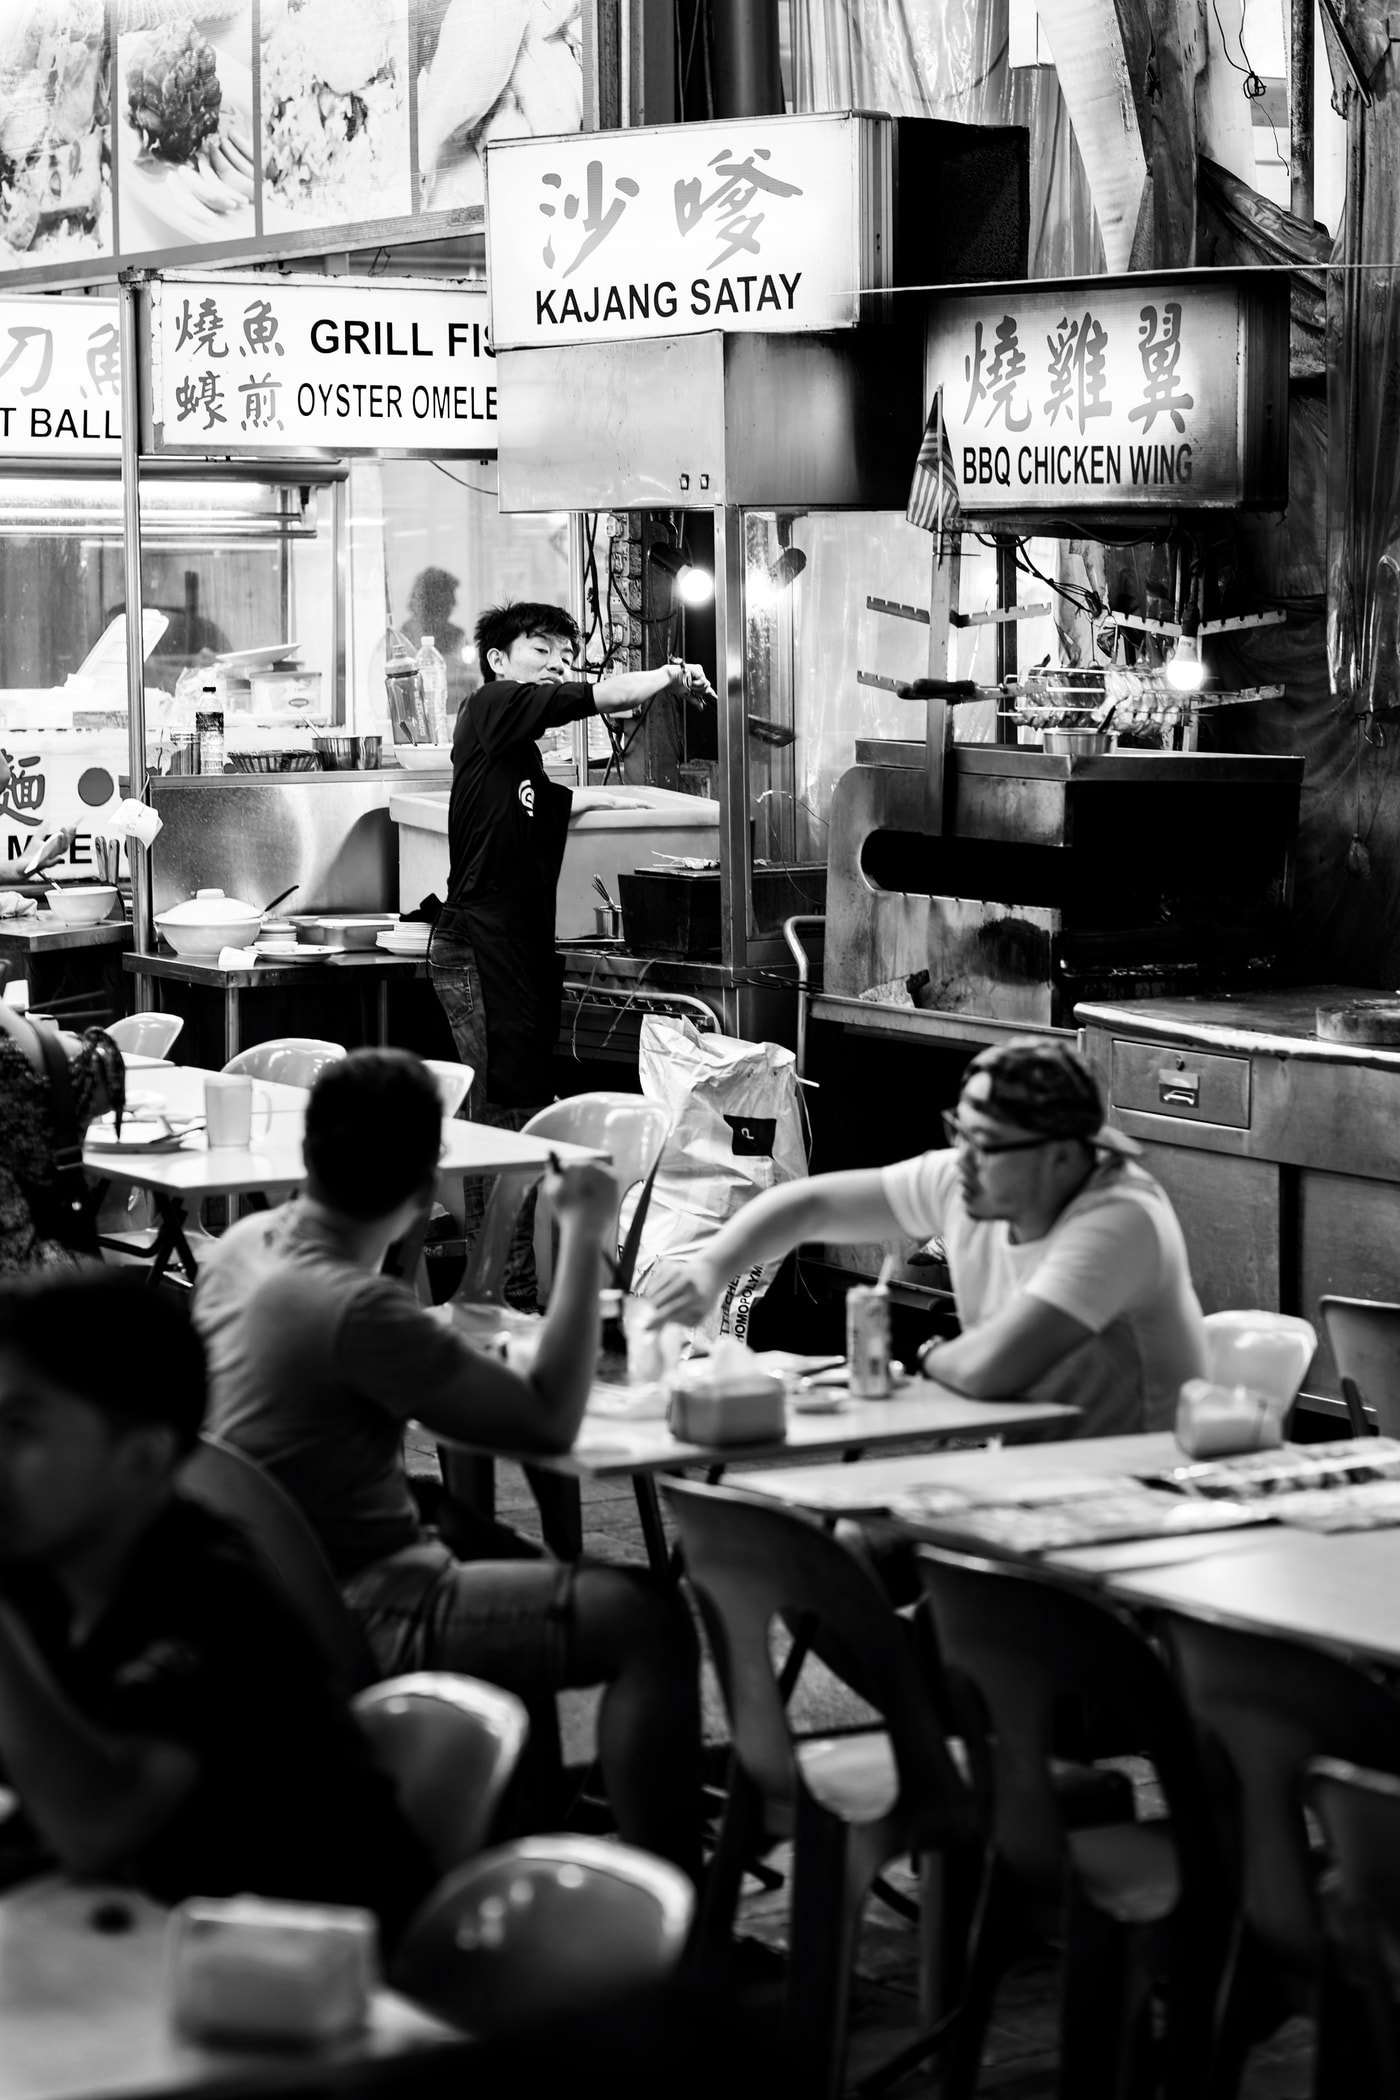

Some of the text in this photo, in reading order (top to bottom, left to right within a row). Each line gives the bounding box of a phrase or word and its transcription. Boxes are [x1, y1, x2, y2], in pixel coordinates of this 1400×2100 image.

[536, 272, 802, 325] KAJANG SATAY
[175, 298, 285, 358] 燒魚
[310, 319, 434, 357] GRILL
[297, 382, 498, 420] OYSTER OMELE
[30, 408, 122, 439] BALL
[963, 443, 1194, 487] BBQ CHICKEN WING
[7, 834, 93, 864] ME
